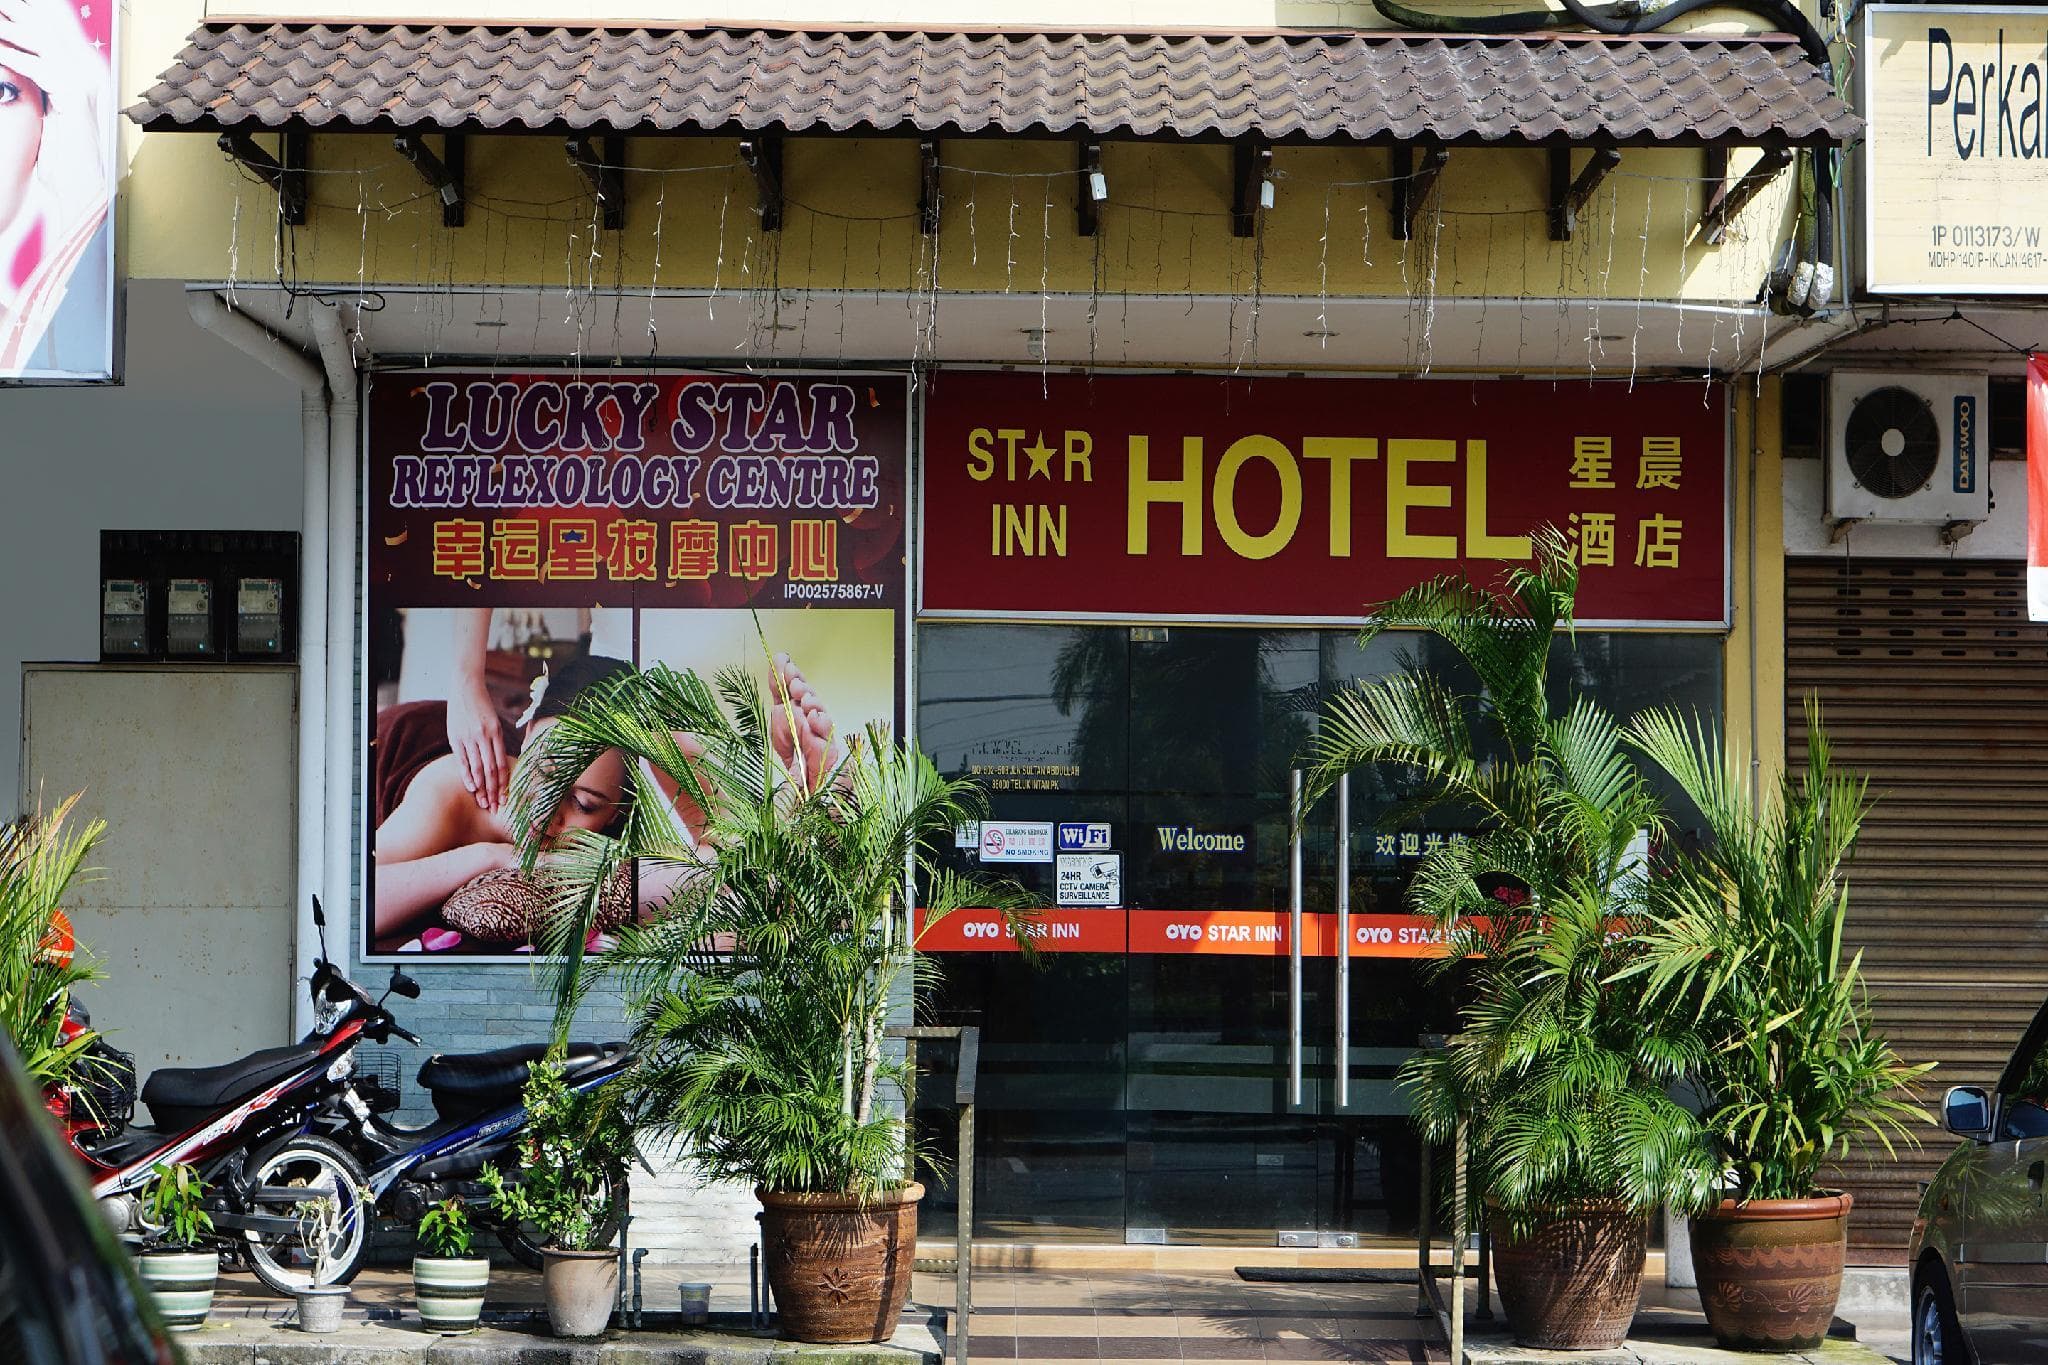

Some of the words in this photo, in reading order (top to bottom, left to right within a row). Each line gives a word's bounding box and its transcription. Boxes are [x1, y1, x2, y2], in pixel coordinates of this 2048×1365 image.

[1927, 27, 2048, 161] Perka
[421, 382, 658, 453] LUCKY
[671, 383, 858, 453] STAR
[1959, 401, 1969, 489] DAEWOO
[1568, 436, 1683, 490] 星晨
[390, 455, 701, 508] REFLEXOLOGY
[706, 456, 879, 509] CENTRE
[1127, 434, 1532, 560] HOTEL
[992, 504, 1066, 557] INN
[1566, 512, 1683, 569] 酒店
[433, 518, 838, 581] 幸运星按摩中心
[784, 583, 884, 599] IP002575867-V
[1022, 765, 1045, 775] SULTAN
[1046, 765, 1080, 776] ABDULLAH
[1005, 848, 1016, 856] NO
[1017, 848, 1049, 856] SMOKING
[1157, 825, 1245, 852] Welcome
[1059, 882, 1078, 891] CCTV
[1080, 882, 1110, 891] CAMERA
[1060, 871, 1081, 881] 24HR
[1059, 891, 1110, 900] SURVEILLANCE
[963, 922, 999, 938] OYO
[1005, 923, 1047, 938] SAR
[1052, 923, 1080, 938] INN
[1165, 924, 1203, 940] OYO
[1207, 925, 1251, 942] STAR
[1255, 925, 1282, 942] INN
[1356, 927, 1393, 944] OYO
